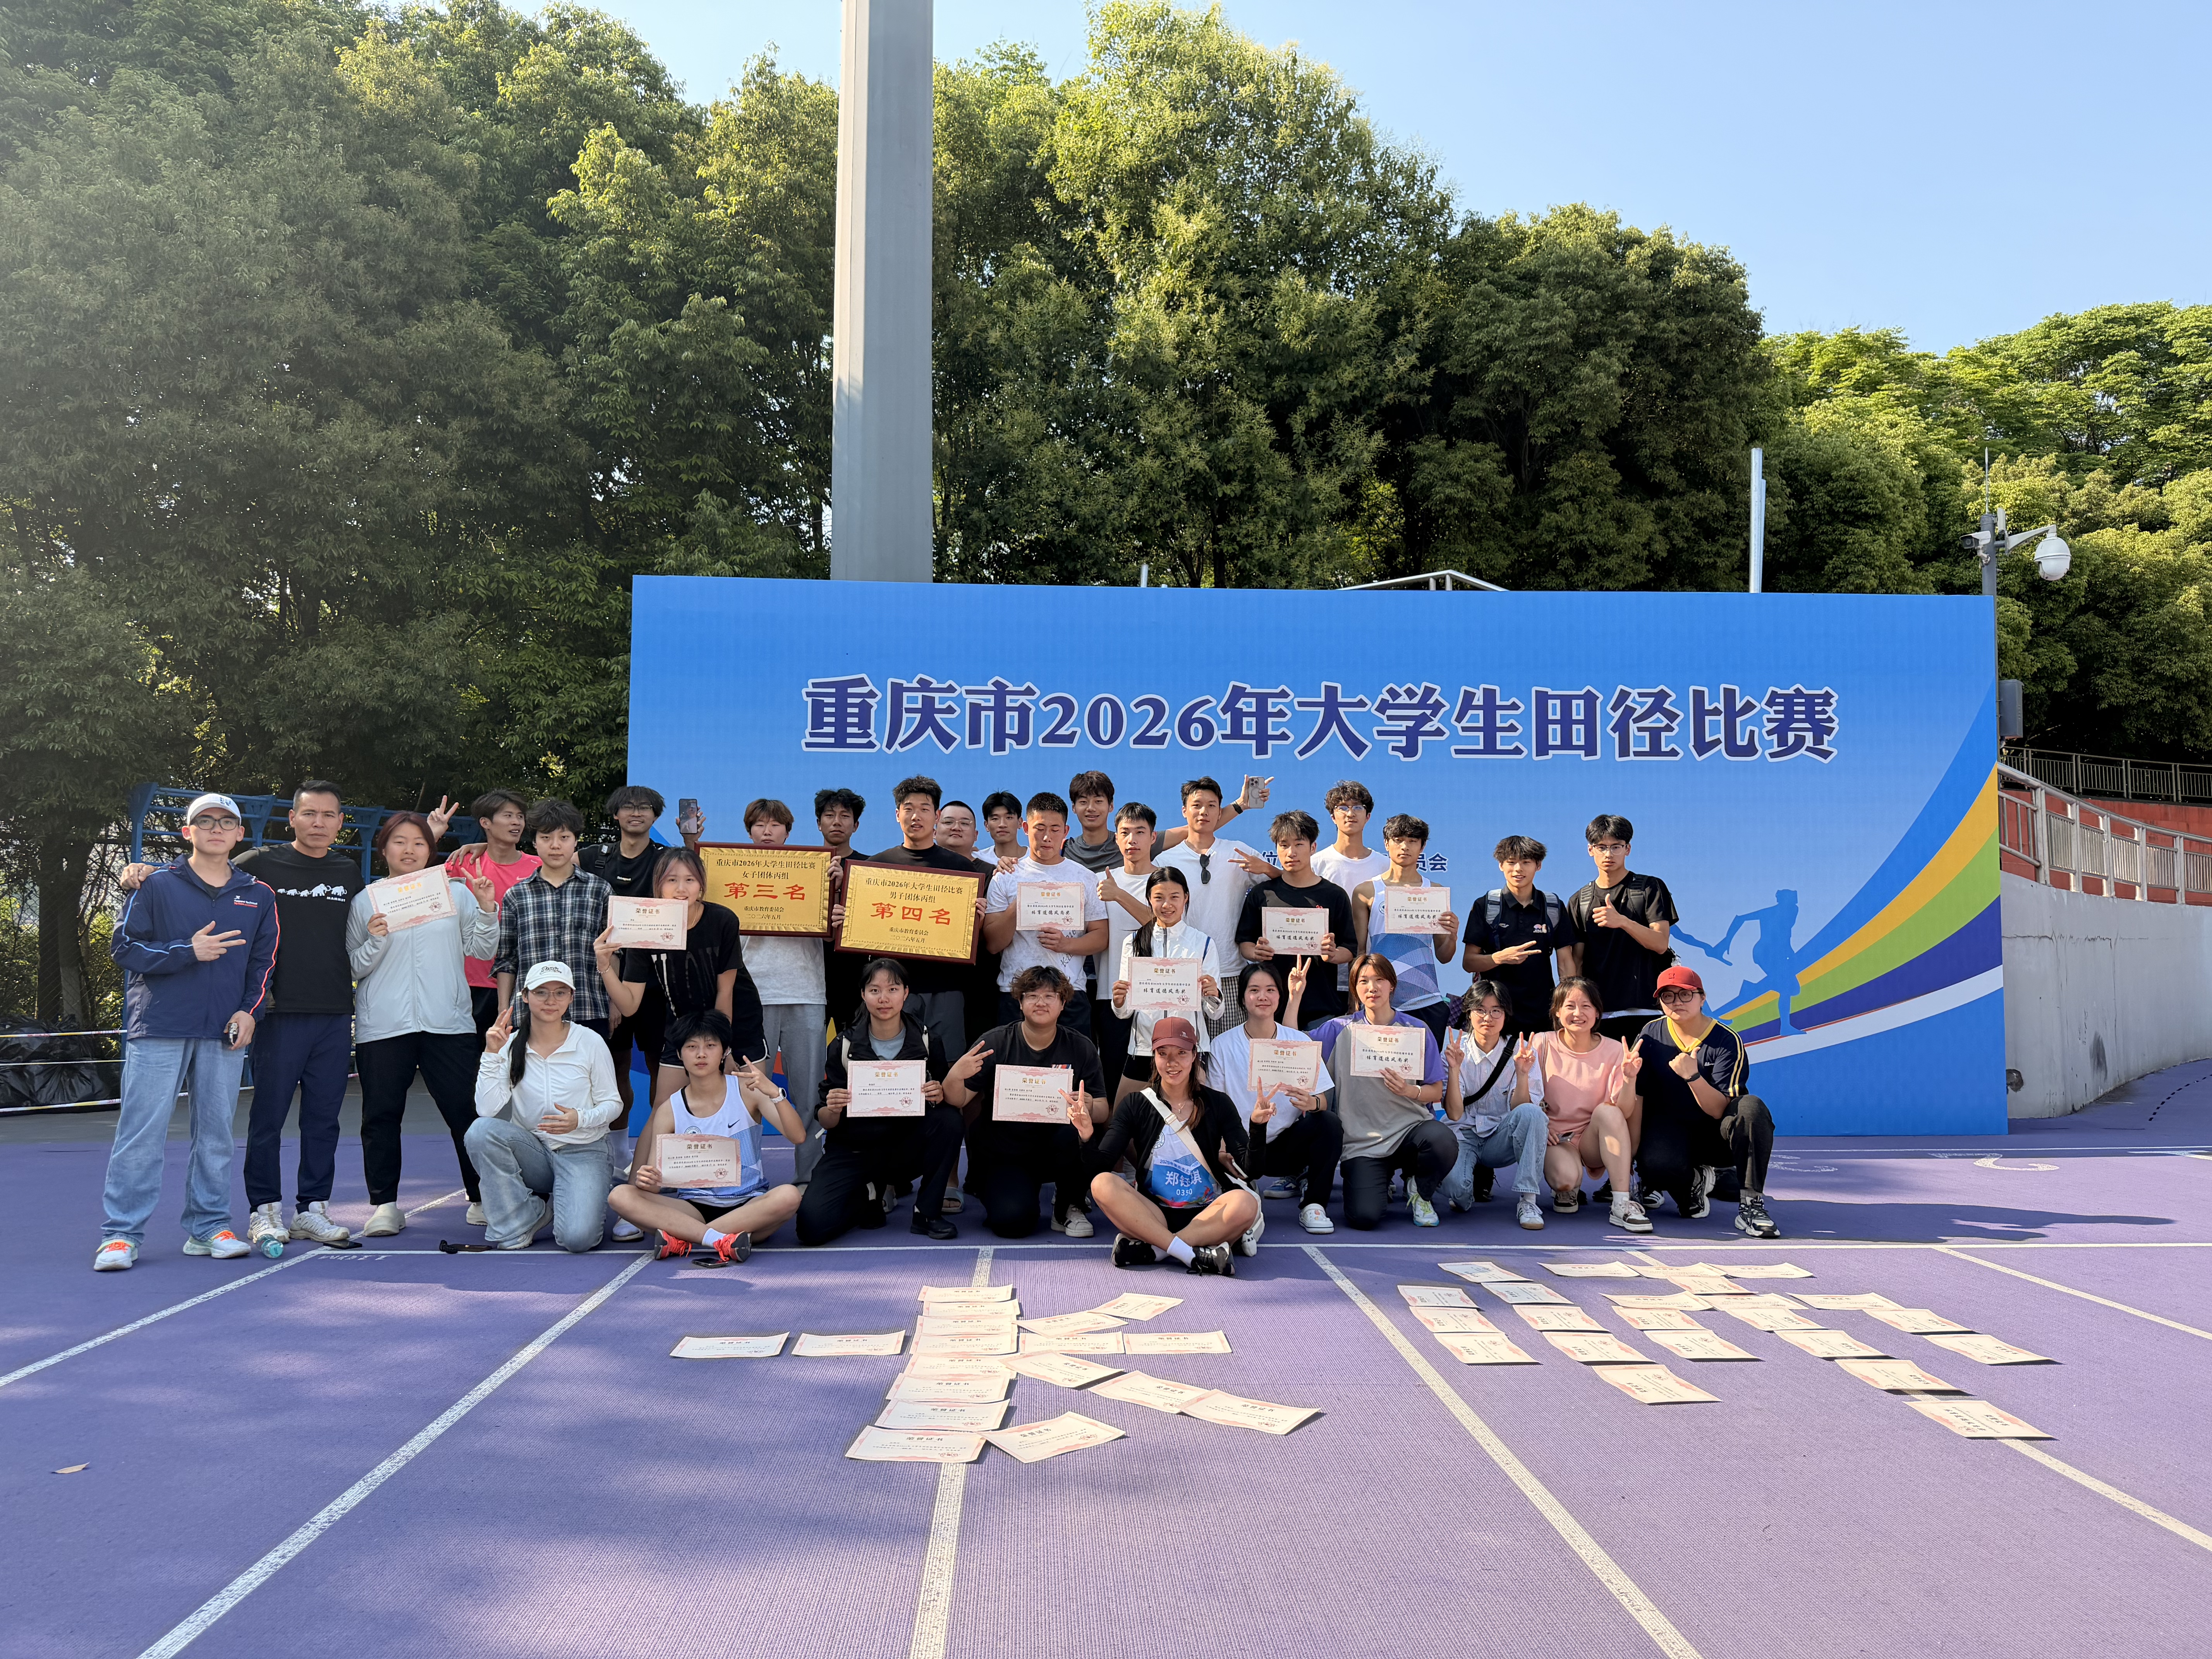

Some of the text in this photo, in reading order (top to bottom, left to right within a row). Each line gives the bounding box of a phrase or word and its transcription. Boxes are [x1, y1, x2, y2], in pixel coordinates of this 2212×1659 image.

[804, 676, 1838, 762] 重庆市2026年大学生田径比赛
[716, 859, 816, 869] 重庆市2026年大学生田径比赛
[742, 871, 789, 879] 女子团体丙组
[724, 882, 805, 900] 第三名
[866, 878, 963, 895] 重庆市2026年大学生田径比赛
[890, 891, 936, 903] 男子团体丙组
[871, 902, 950, 925] 第四名
